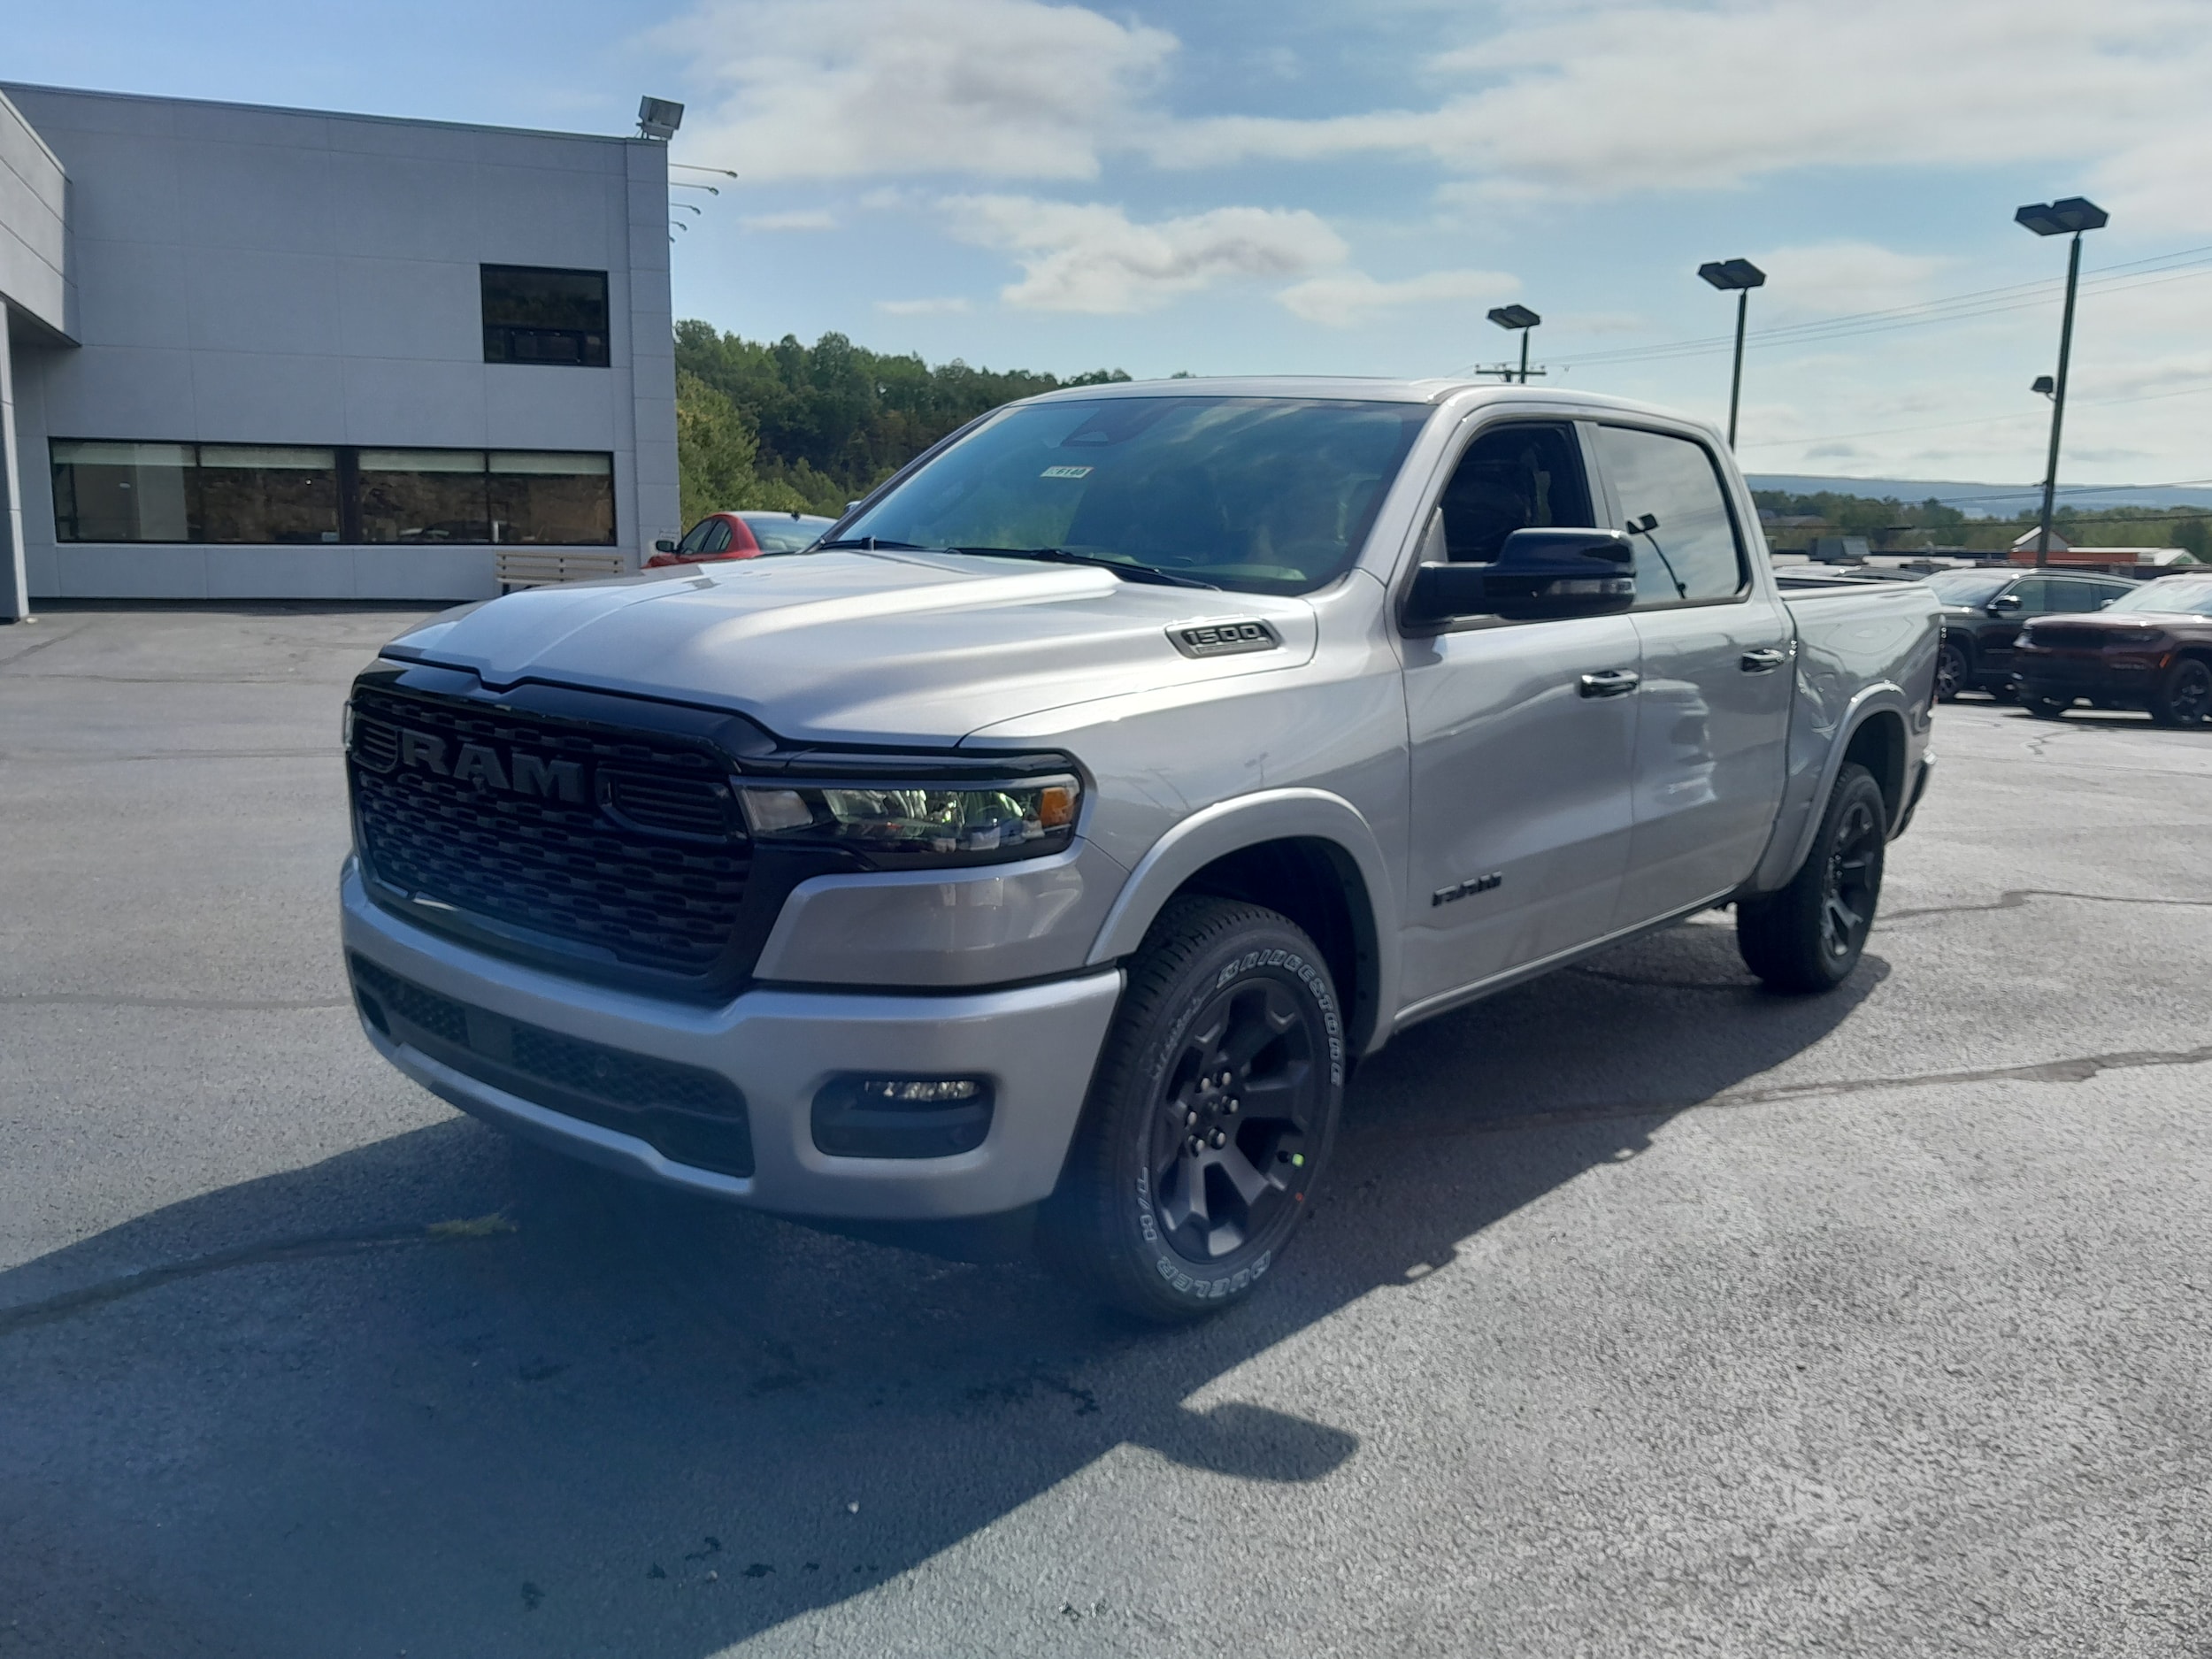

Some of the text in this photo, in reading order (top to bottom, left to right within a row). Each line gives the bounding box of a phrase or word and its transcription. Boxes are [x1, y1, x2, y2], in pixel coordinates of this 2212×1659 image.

[1186, 624, 1262, 646] 1500
[403, 727, 585, 803] RAM
[1432, 871, 1502, 907] RAM
[1216, 949, 1341, 1087] BRIDGESTONE
[1156, 1249, 1271, 1299] DUELER
